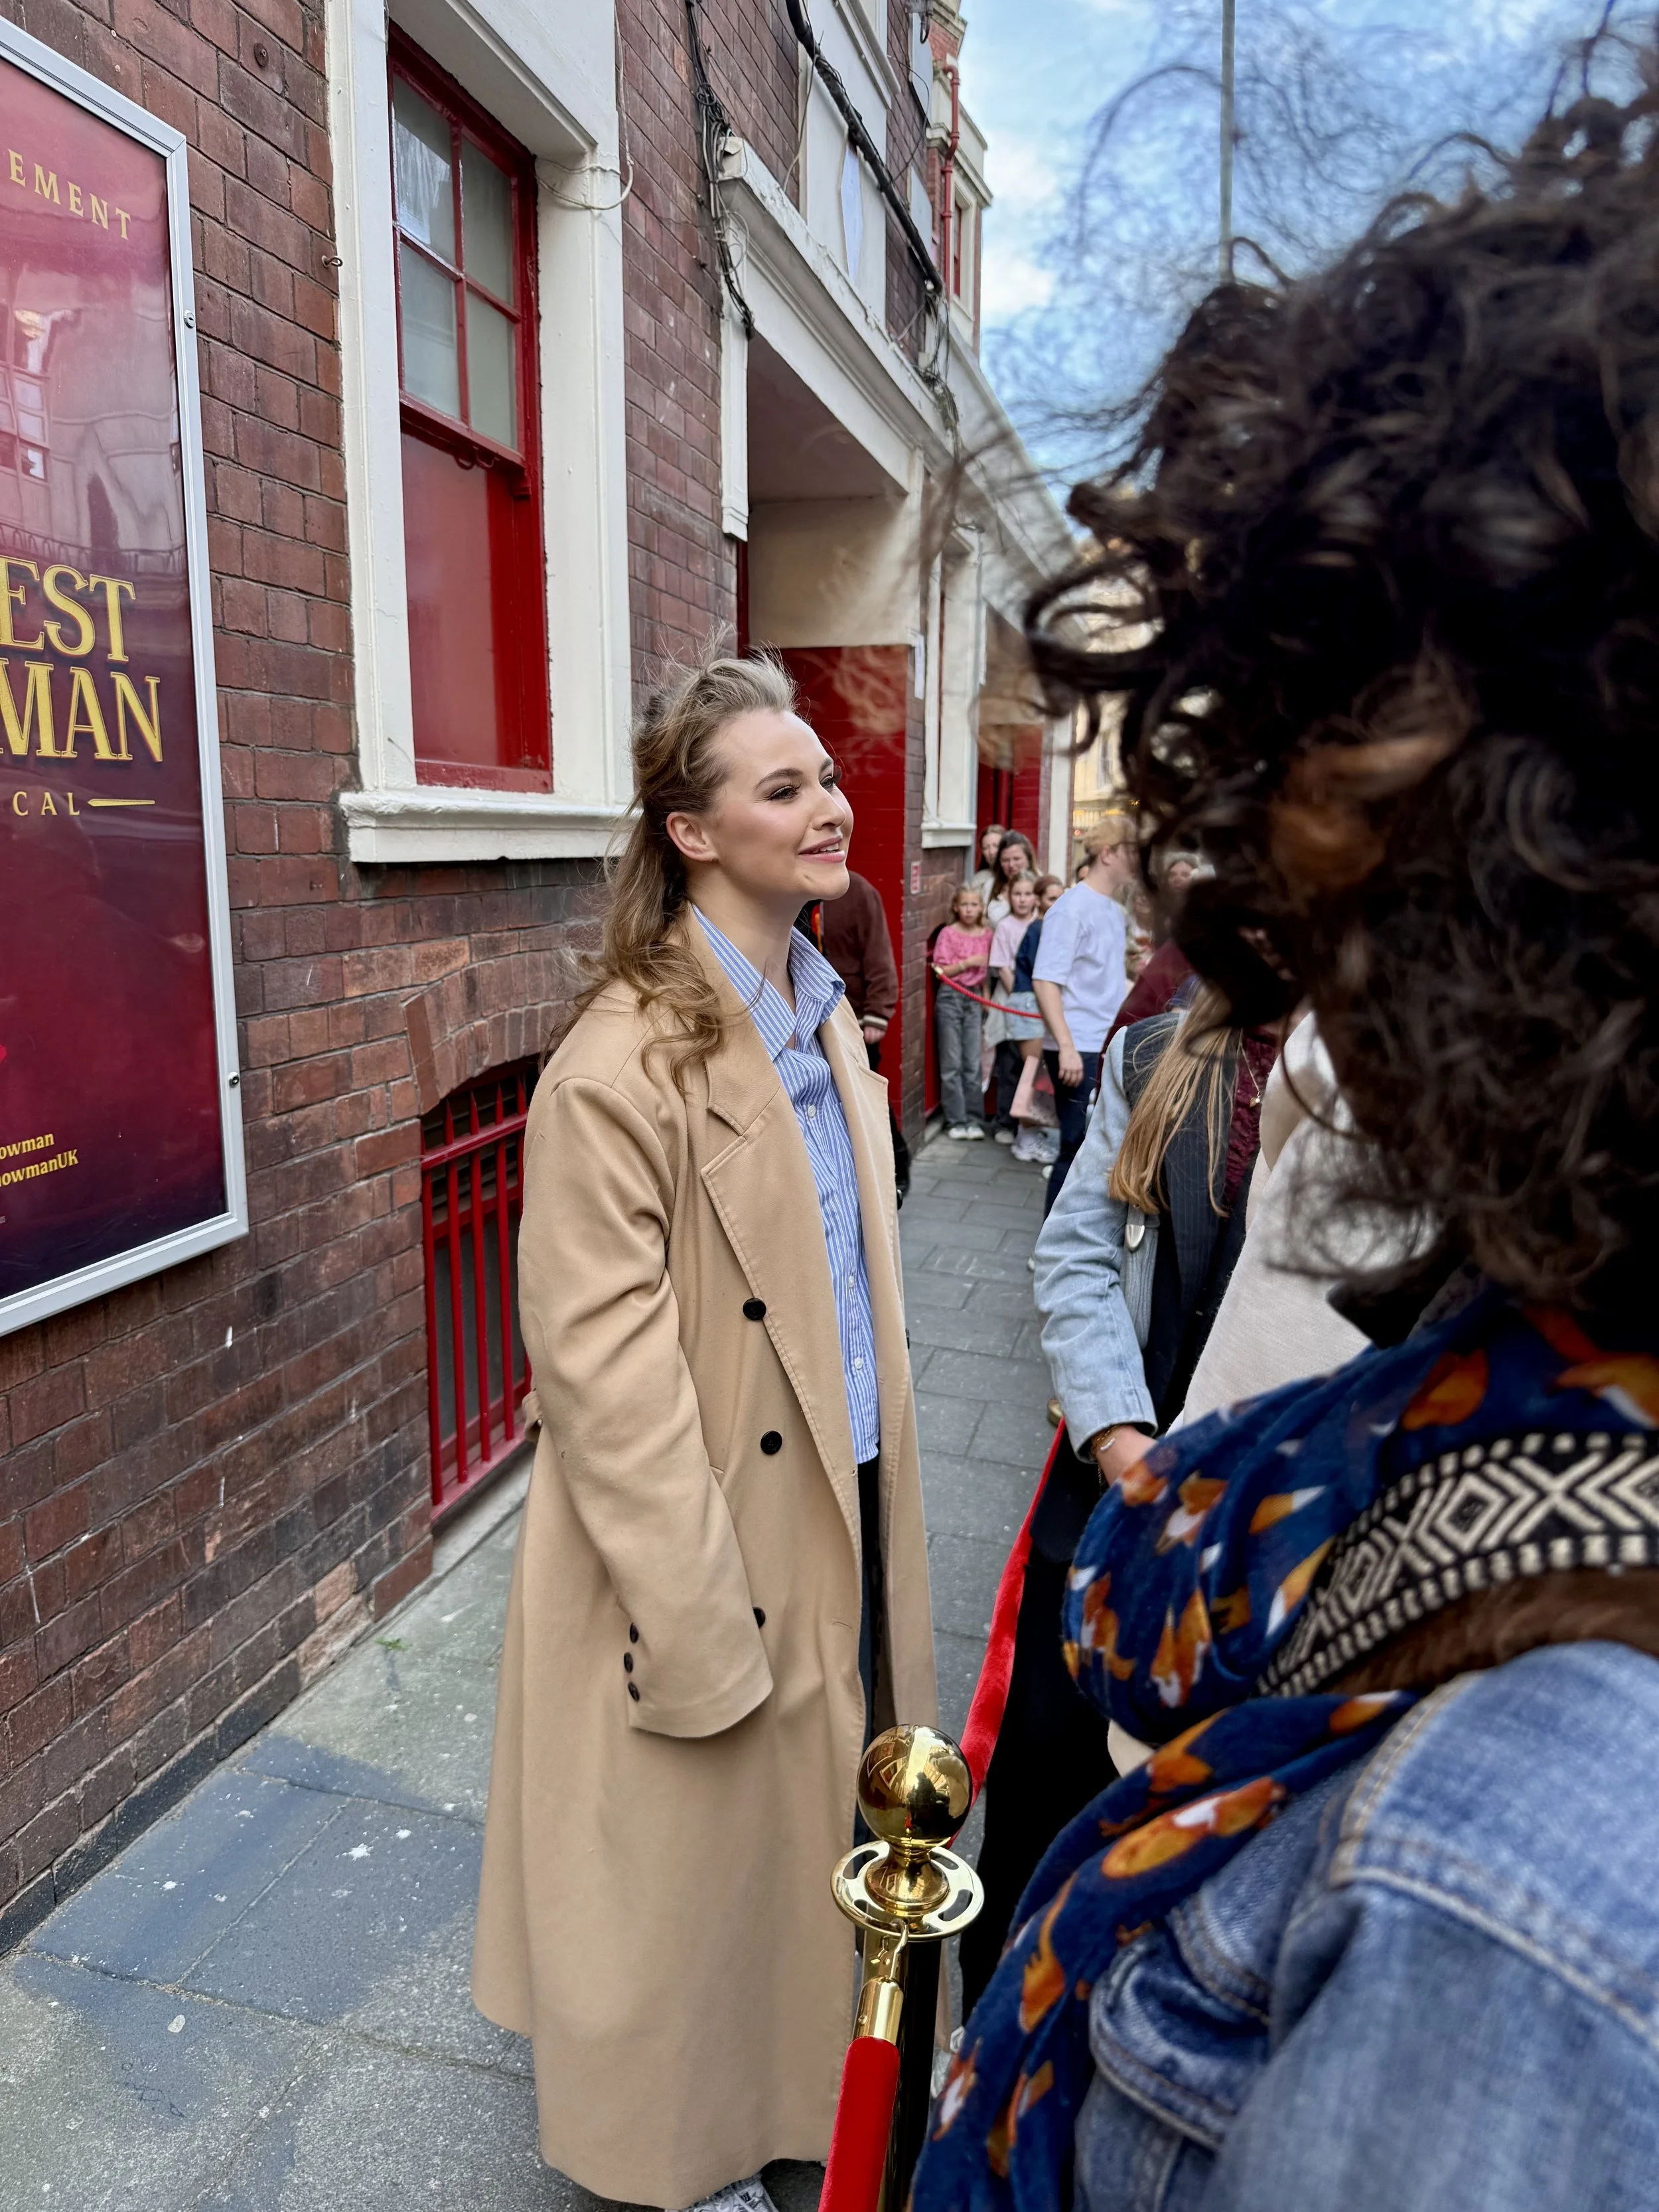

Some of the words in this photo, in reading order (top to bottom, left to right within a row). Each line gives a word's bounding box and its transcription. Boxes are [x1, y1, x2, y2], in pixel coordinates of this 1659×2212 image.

[8, 149, 132, 241] EMENT
[0, 555, 136, 662] EST
[0, 657, 163, 762] MAN
[13, 791, 80, 816] CAL
[0, 1149, 79, 1187] owmanUK
